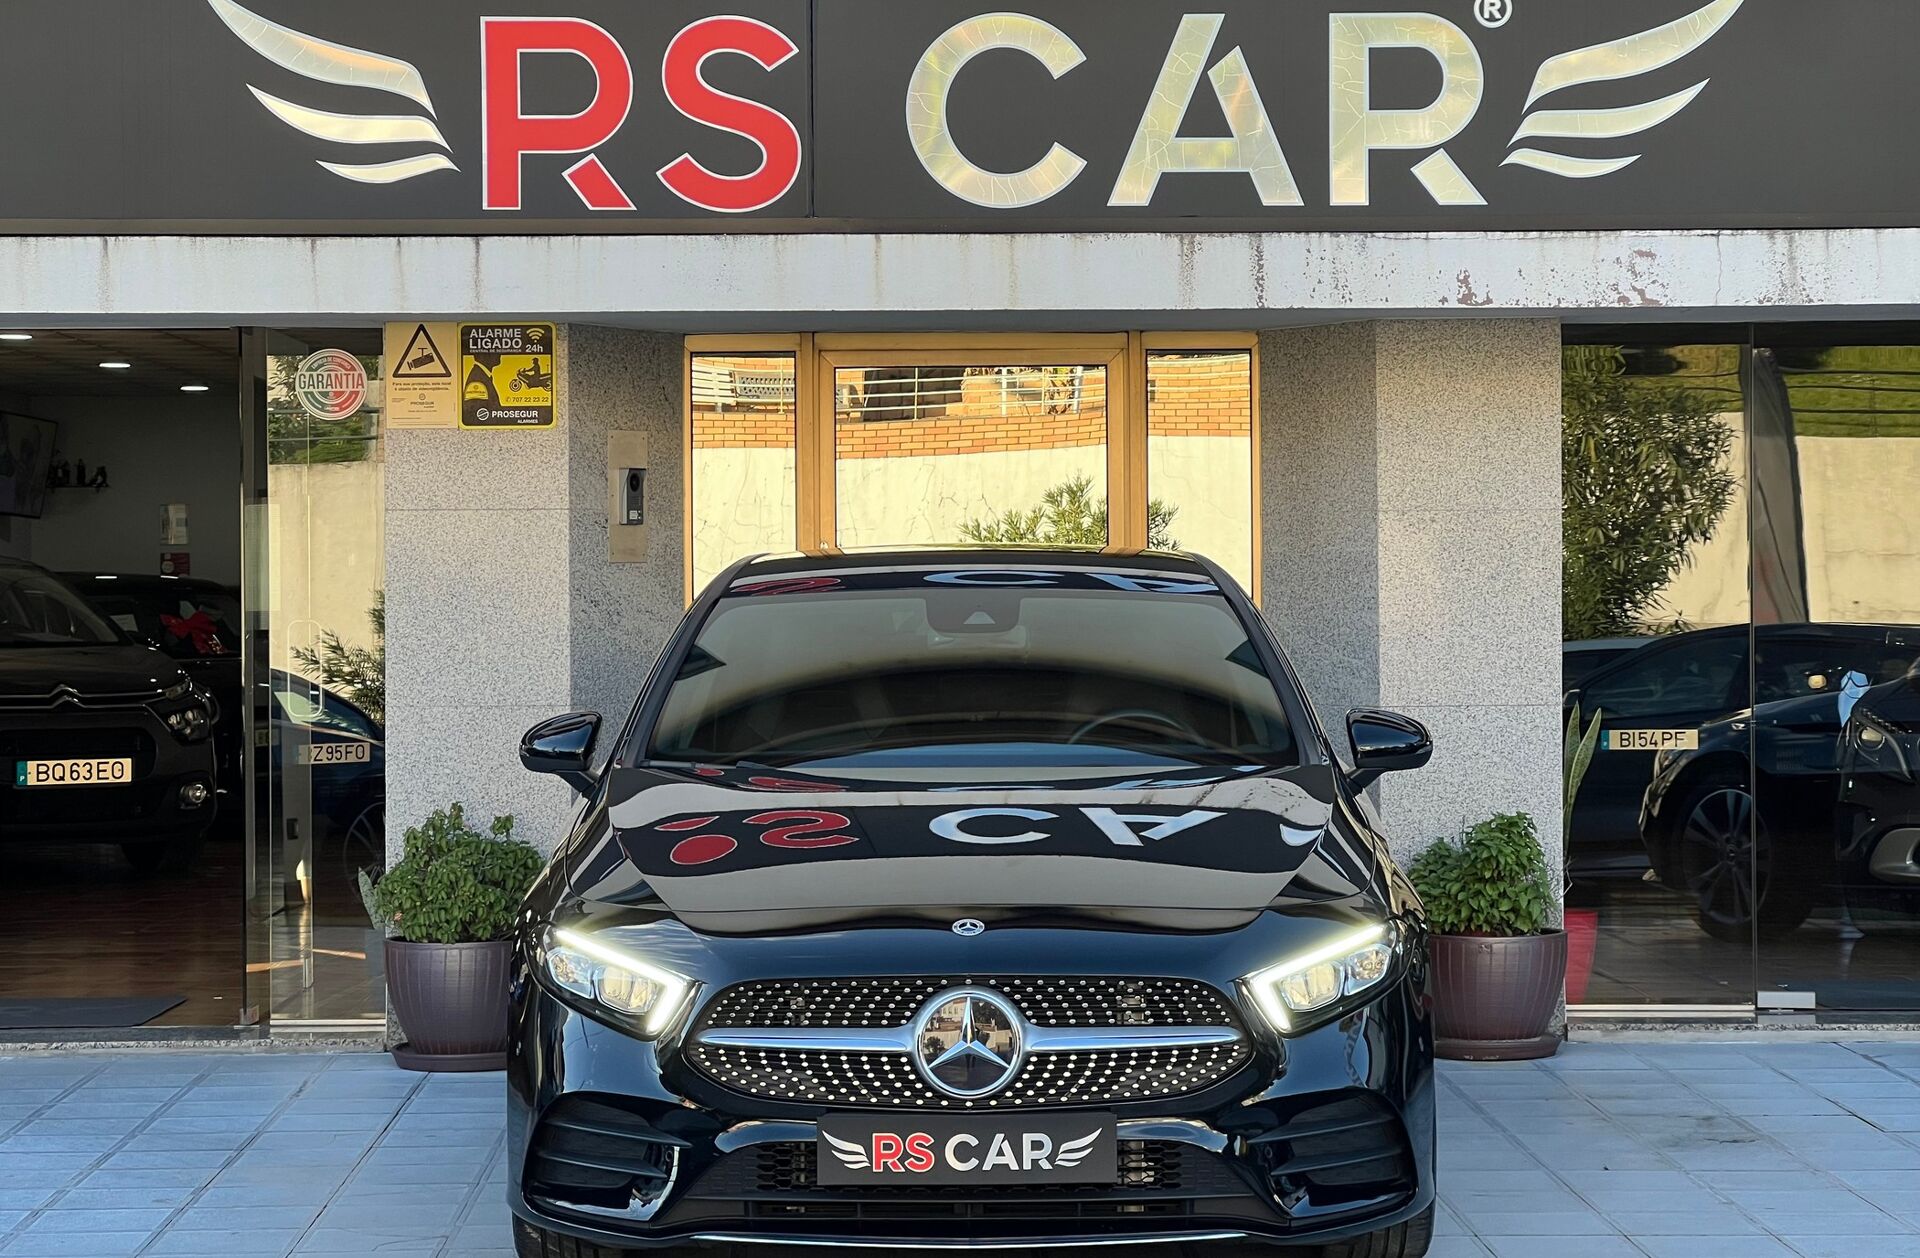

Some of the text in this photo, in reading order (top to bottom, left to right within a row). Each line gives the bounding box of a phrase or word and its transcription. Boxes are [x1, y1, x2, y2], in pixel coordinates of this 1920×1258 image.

[480, 12, 1489, 213] RS CAR
[470, 328, 522, 338] ALARME
[469, 338, 544, 353] LIGADO 24h
[298, 373, 365, 390] GARANTIA
[491, 410, 539, 418] PROSEGUR
[871, 1131, 1054, 1173] RS CAR
